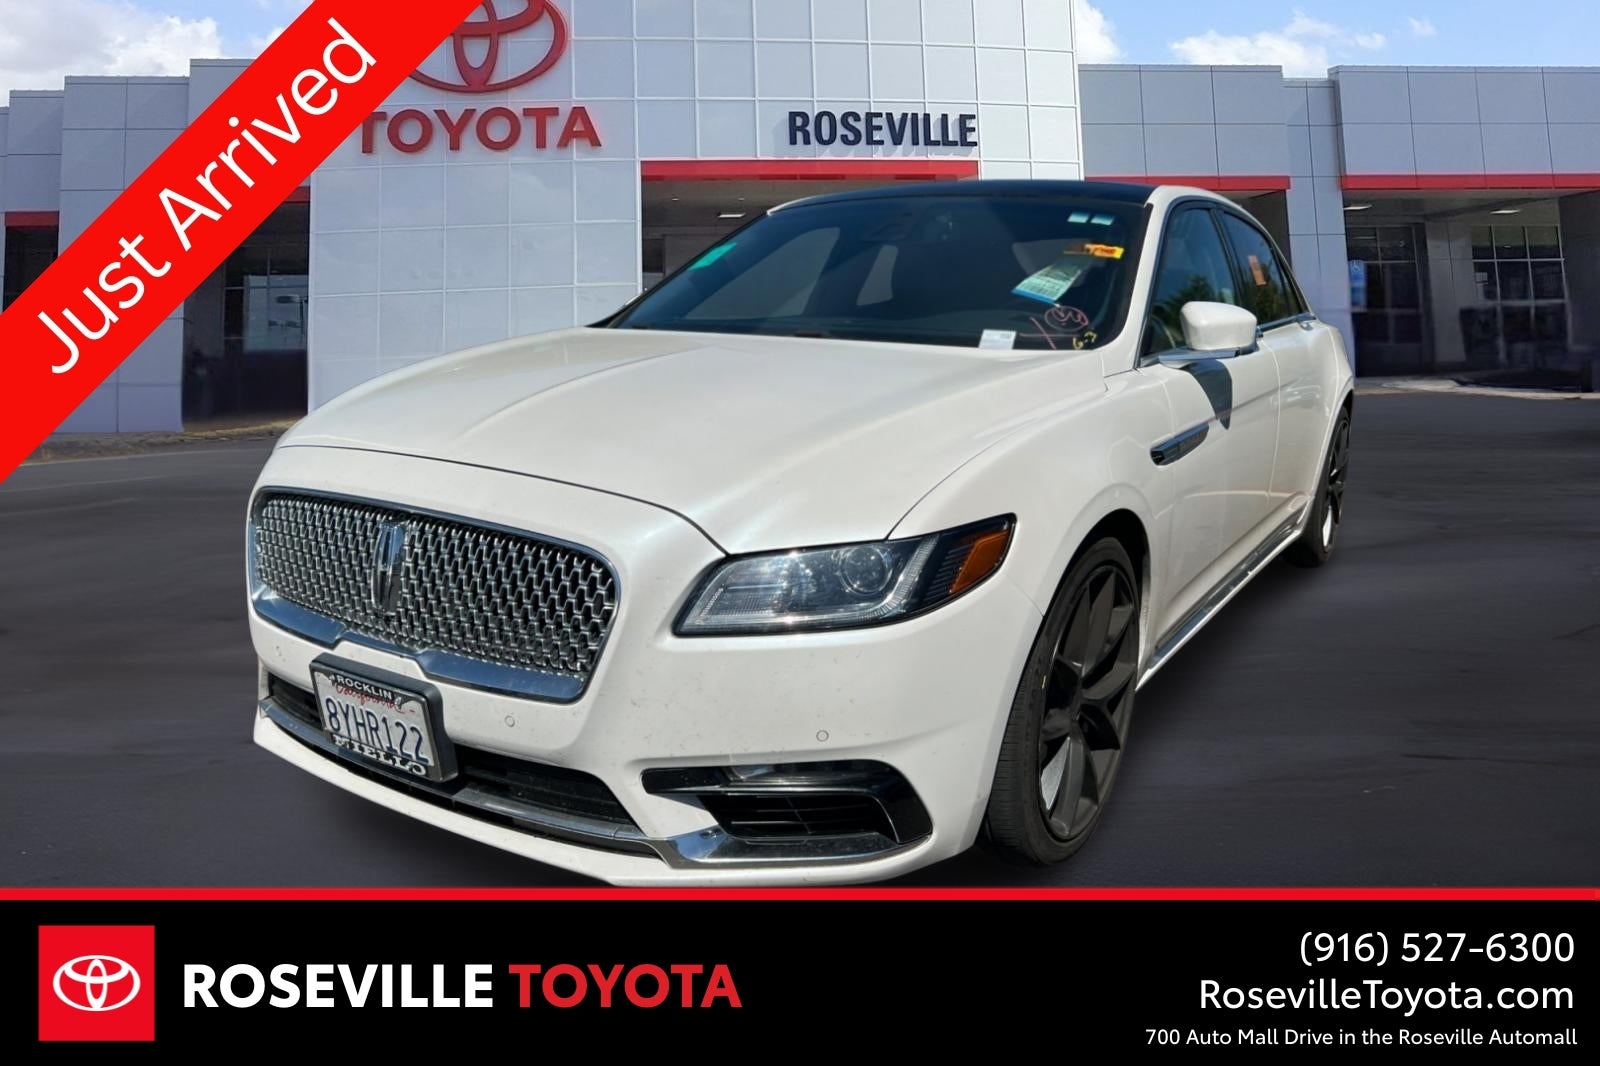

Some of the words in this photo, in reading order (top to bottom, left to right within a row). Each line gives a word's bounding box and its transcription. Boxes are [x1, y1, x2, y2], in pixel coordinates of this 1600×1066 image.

[361, 106, 602, 154] TOYOTA
[788, 110, 978, 147] ROSEVILLE
[336, 674, 393, 701] ROCKLIN
[325, 696, 429, 765] 8YHR122
